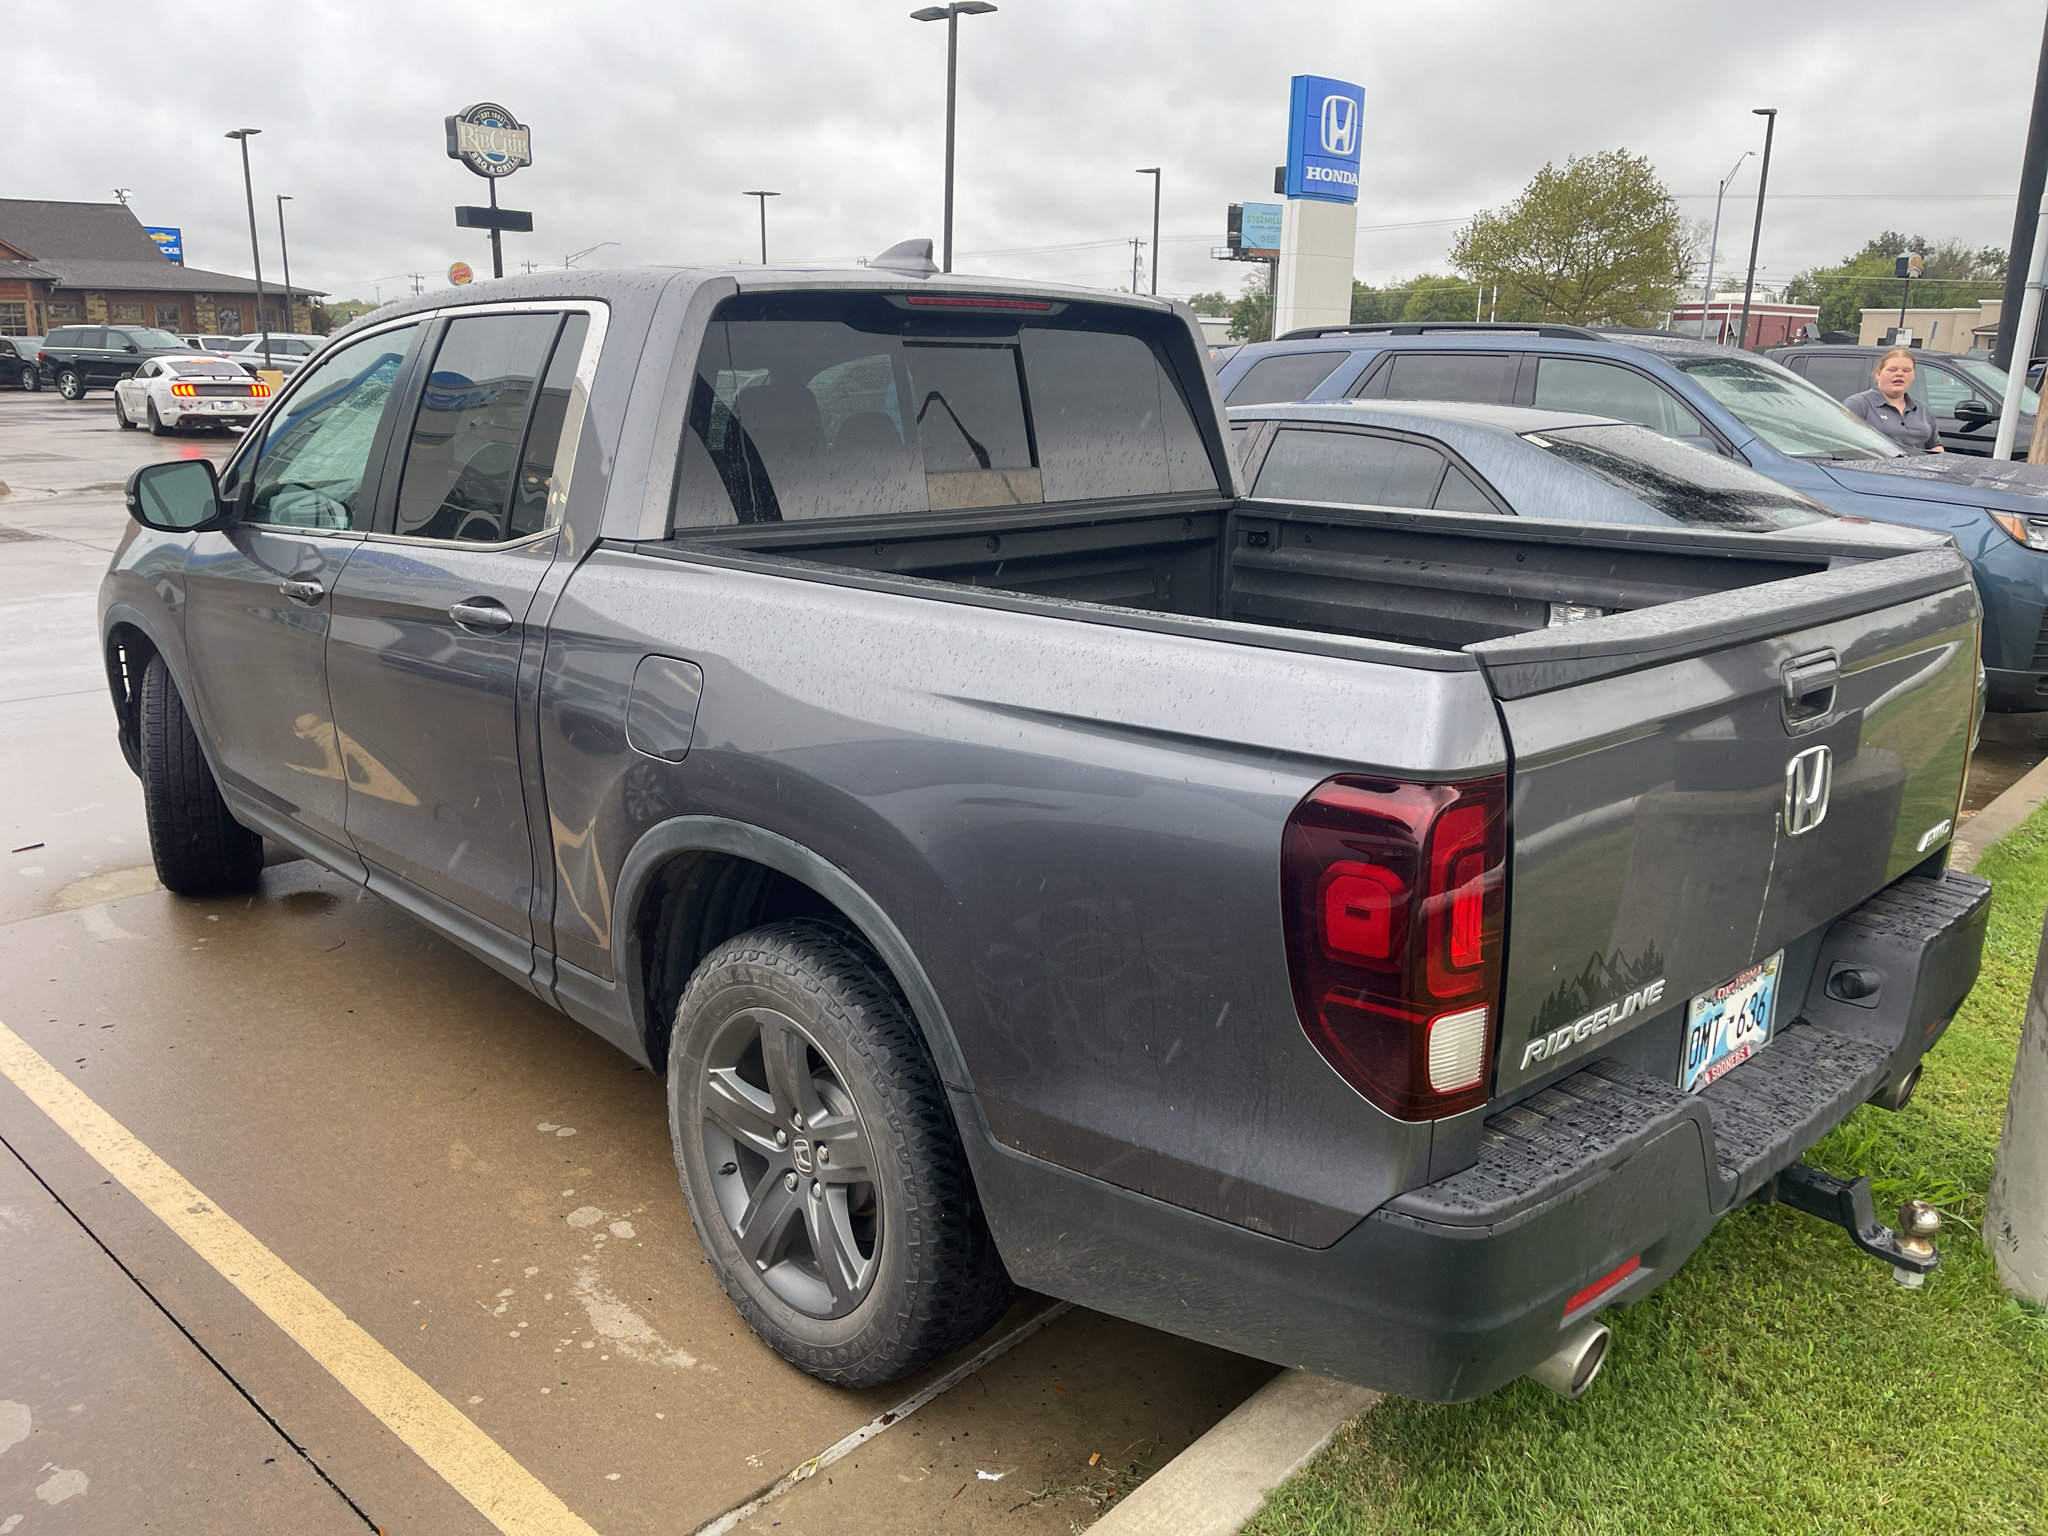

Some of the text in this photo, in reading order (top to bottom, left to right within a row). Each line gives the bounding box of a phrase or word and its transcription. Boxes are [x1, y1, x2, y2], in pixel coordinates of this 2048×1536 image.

[496, 156, 518, 173] GRILL
[1305, 166, 1359, 186] HONDA
[453, 271, 471, 281] KING
[1519, 978, 1666, 1071] RIDGELINE
[1711, 1048, 1746, 1080] SOONERS
